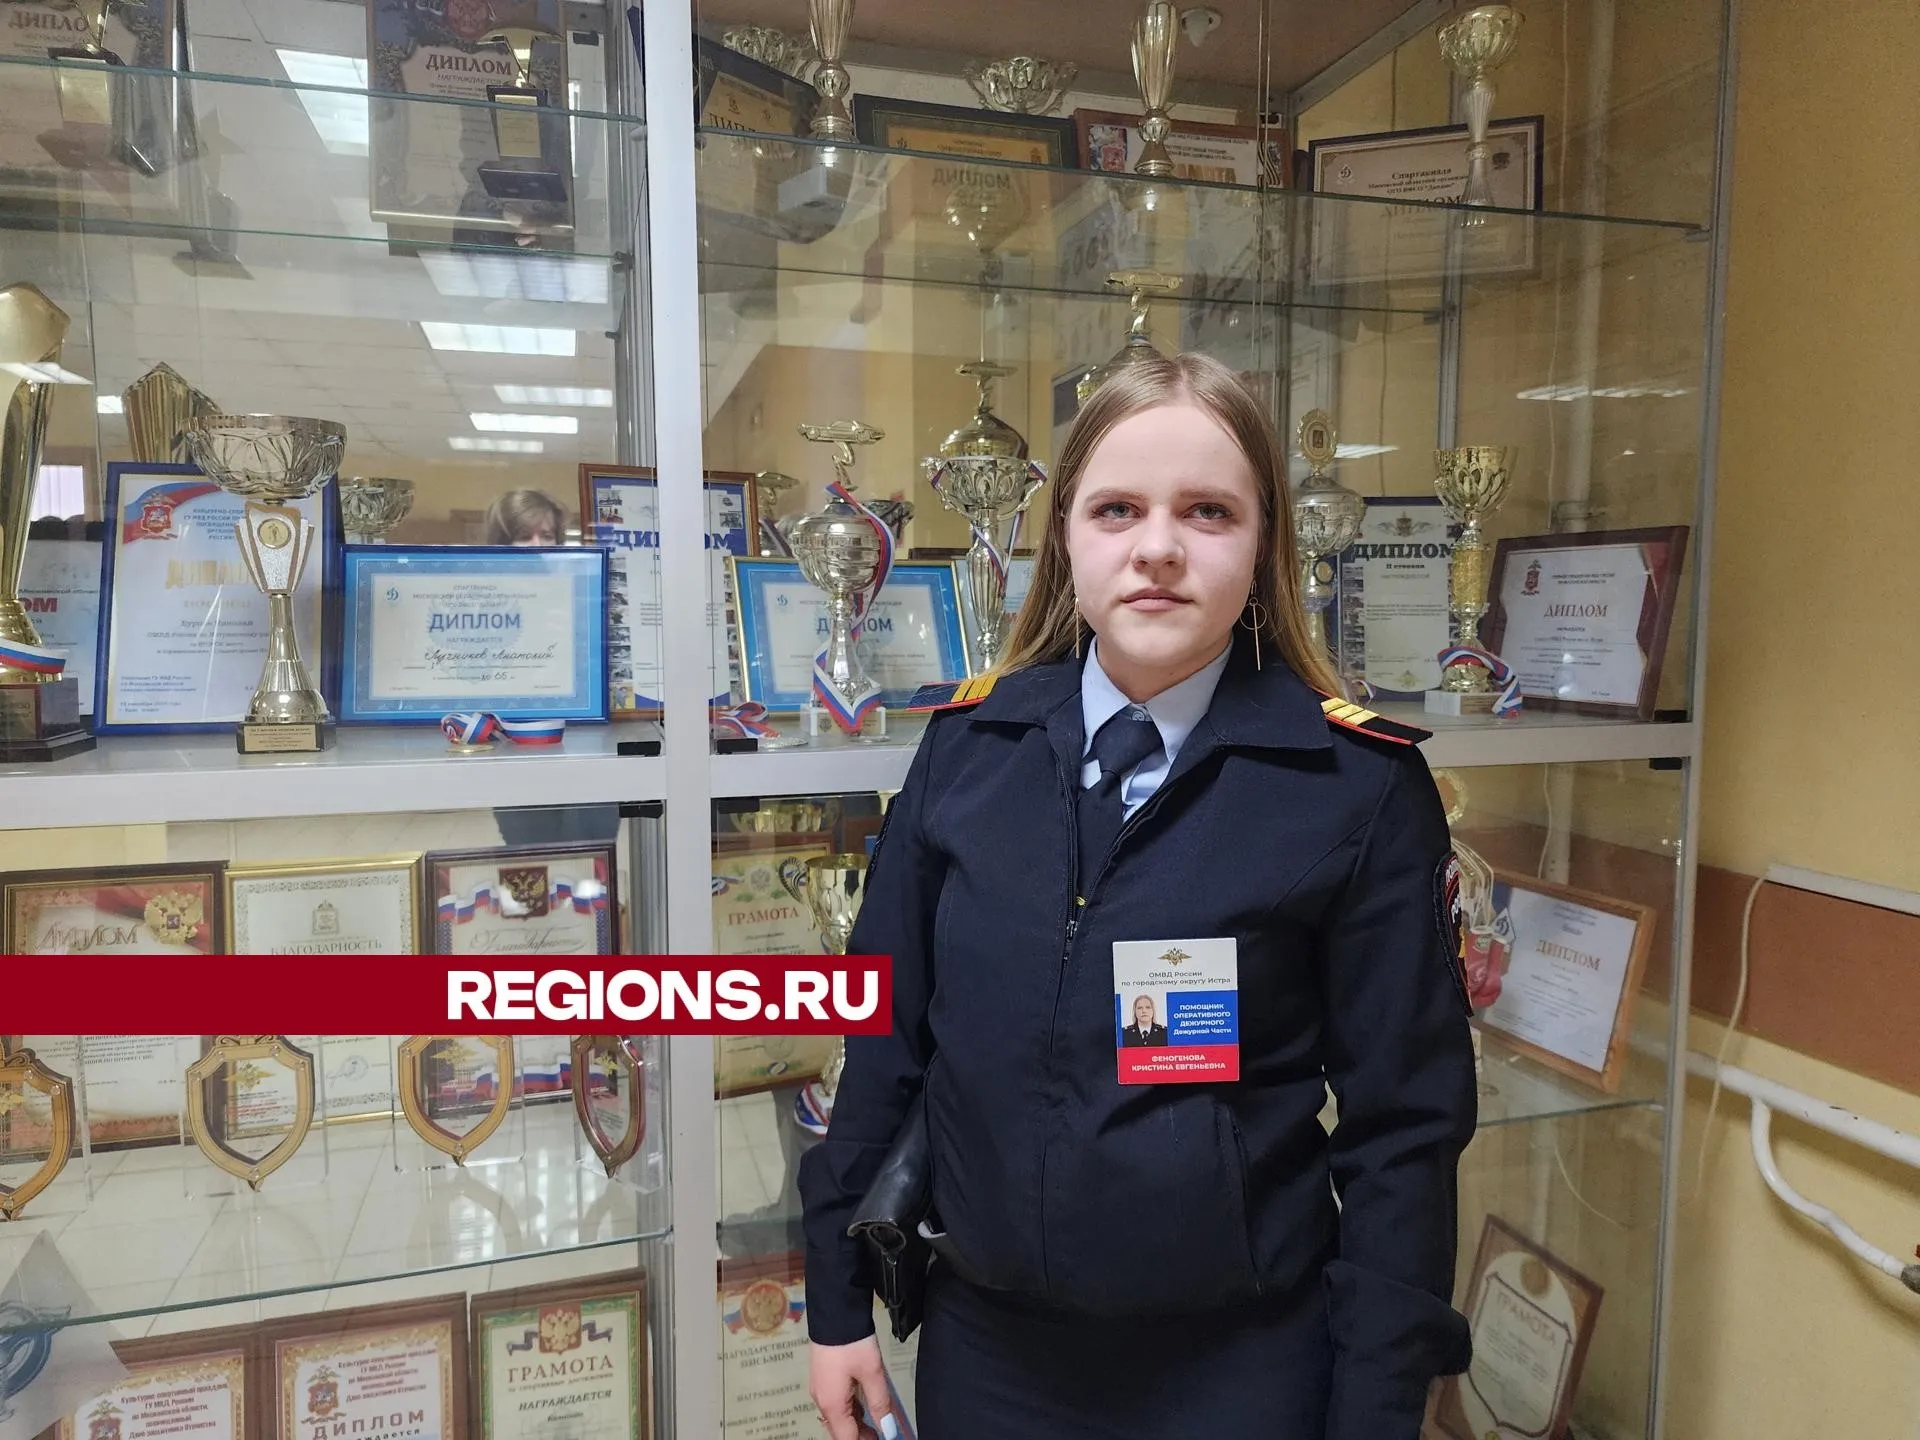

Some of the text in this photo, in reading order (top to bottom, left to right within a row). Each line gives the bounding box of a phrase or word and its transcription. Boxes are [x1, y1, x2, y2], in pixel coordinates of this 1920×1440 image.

[8, 9, 90, 32] ДИПЛО
[425, 54, 512, 76] ДИПЛОМ
[1544, 603, 1608, 618] ДИПЛОМ
[428, 613, 521, 633] ДИПЛОМ
[728, 907, 799, 926] ГРАМОТА
[1132, 979, 1177, 987] городскому
[1179, 978, 1206, 986] округу
[1179, 1003, 1224, 1011] ПОМОЩНИК
[1173, 1011, 1231, 1019] ОПЕРАТИВНОГО
[1179, 1019, 1225, 1027] ДЕЖУРНОГО
[1173, 1027, 1232, 1036] Дежурной Части
[1151, 1054, 1206, 1062] ФЕНОГЕНОВА
[1131, 1062, 1226, 1072] КРИСТИНА ЕВГЕНЬЕВНА
[740, 1352, 794, 1368] ПИСЬМОМ
[508, 1355, 613, 1383] ГРАМОТА
[519, 1390, 612, 1411] НАГРАЖДАЕТСЯ
[312, 1409, 424, 1440] ДИПЛОМ
